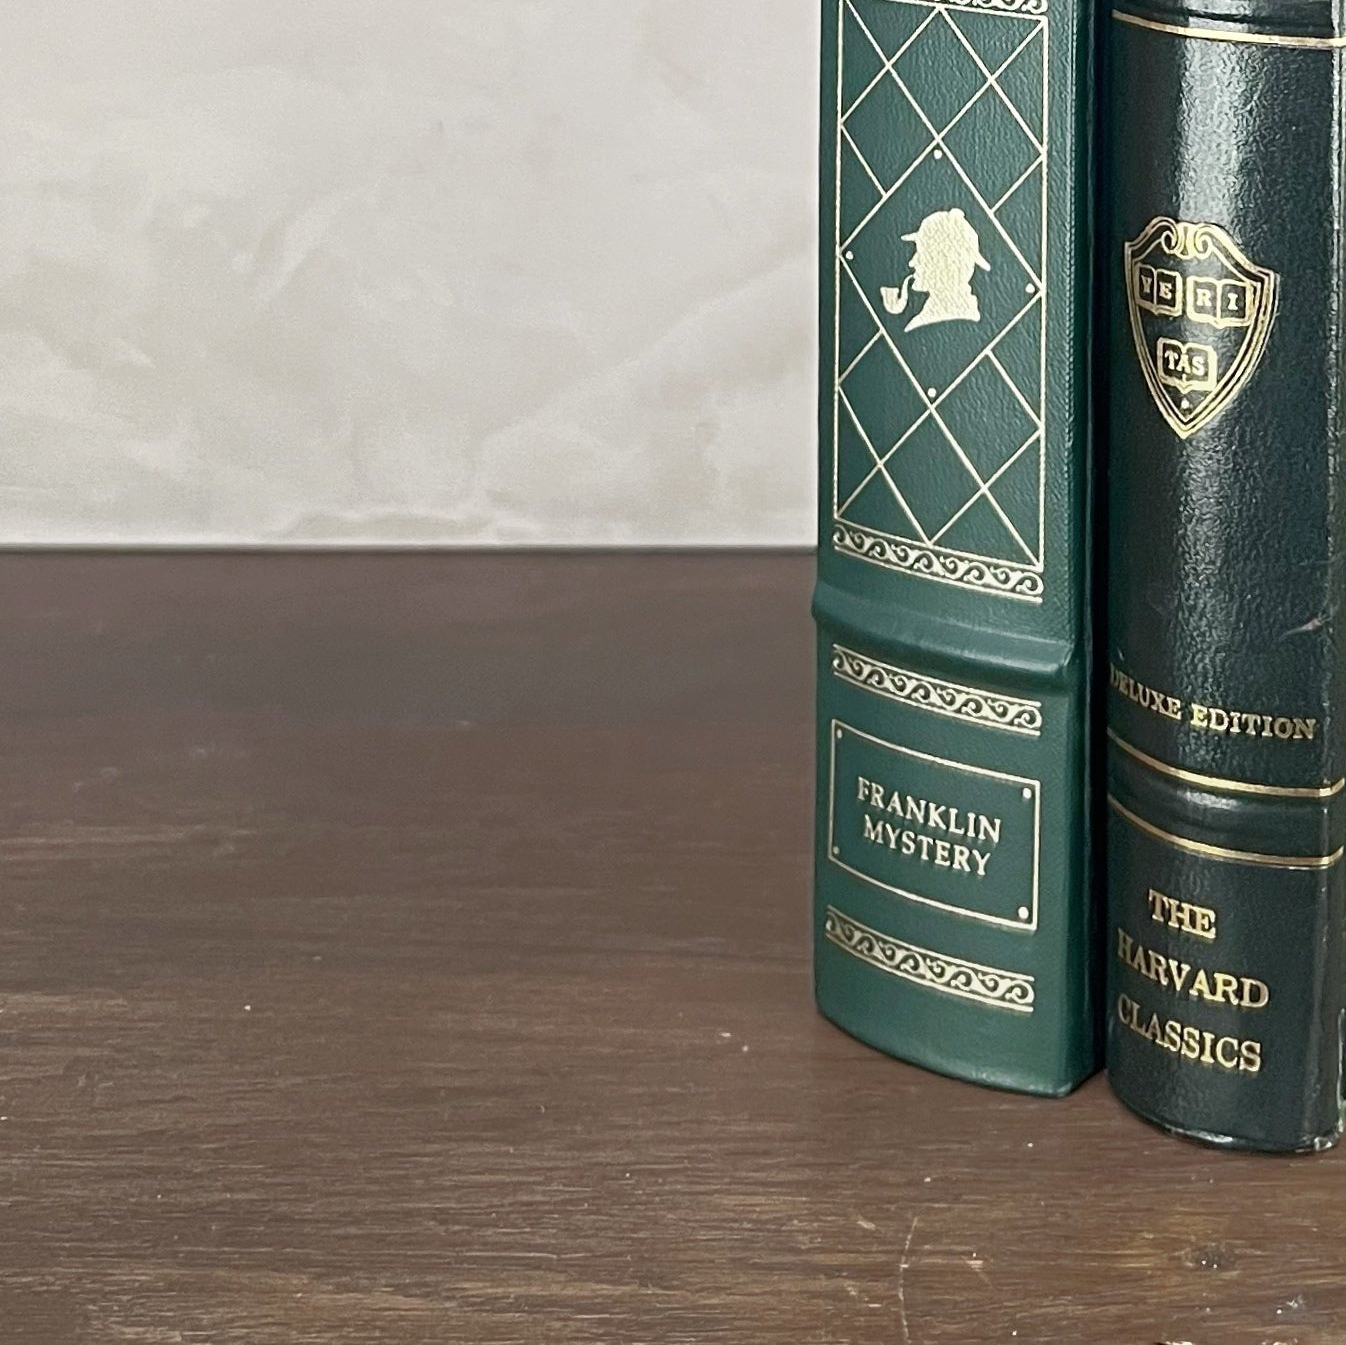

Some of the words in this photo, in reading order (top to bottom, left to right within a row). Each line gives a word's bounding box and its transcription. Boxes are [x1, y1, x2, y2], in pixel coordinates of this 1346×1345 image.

[1164, 351, 1205, 376] TAS
[1109, 662, 1182, 720] DELUXE
[1191, 703, 1316, 739] EDITION
[857, 776, 1001, 843] FRANKLIN
[864, 814, 991, 876] MYSTERY
[1149, 889, 1217, 939] THE
[1118, 927, 1270, 1008] HARVARD
[1117, 993, 1262, 1072] CLASSICS
